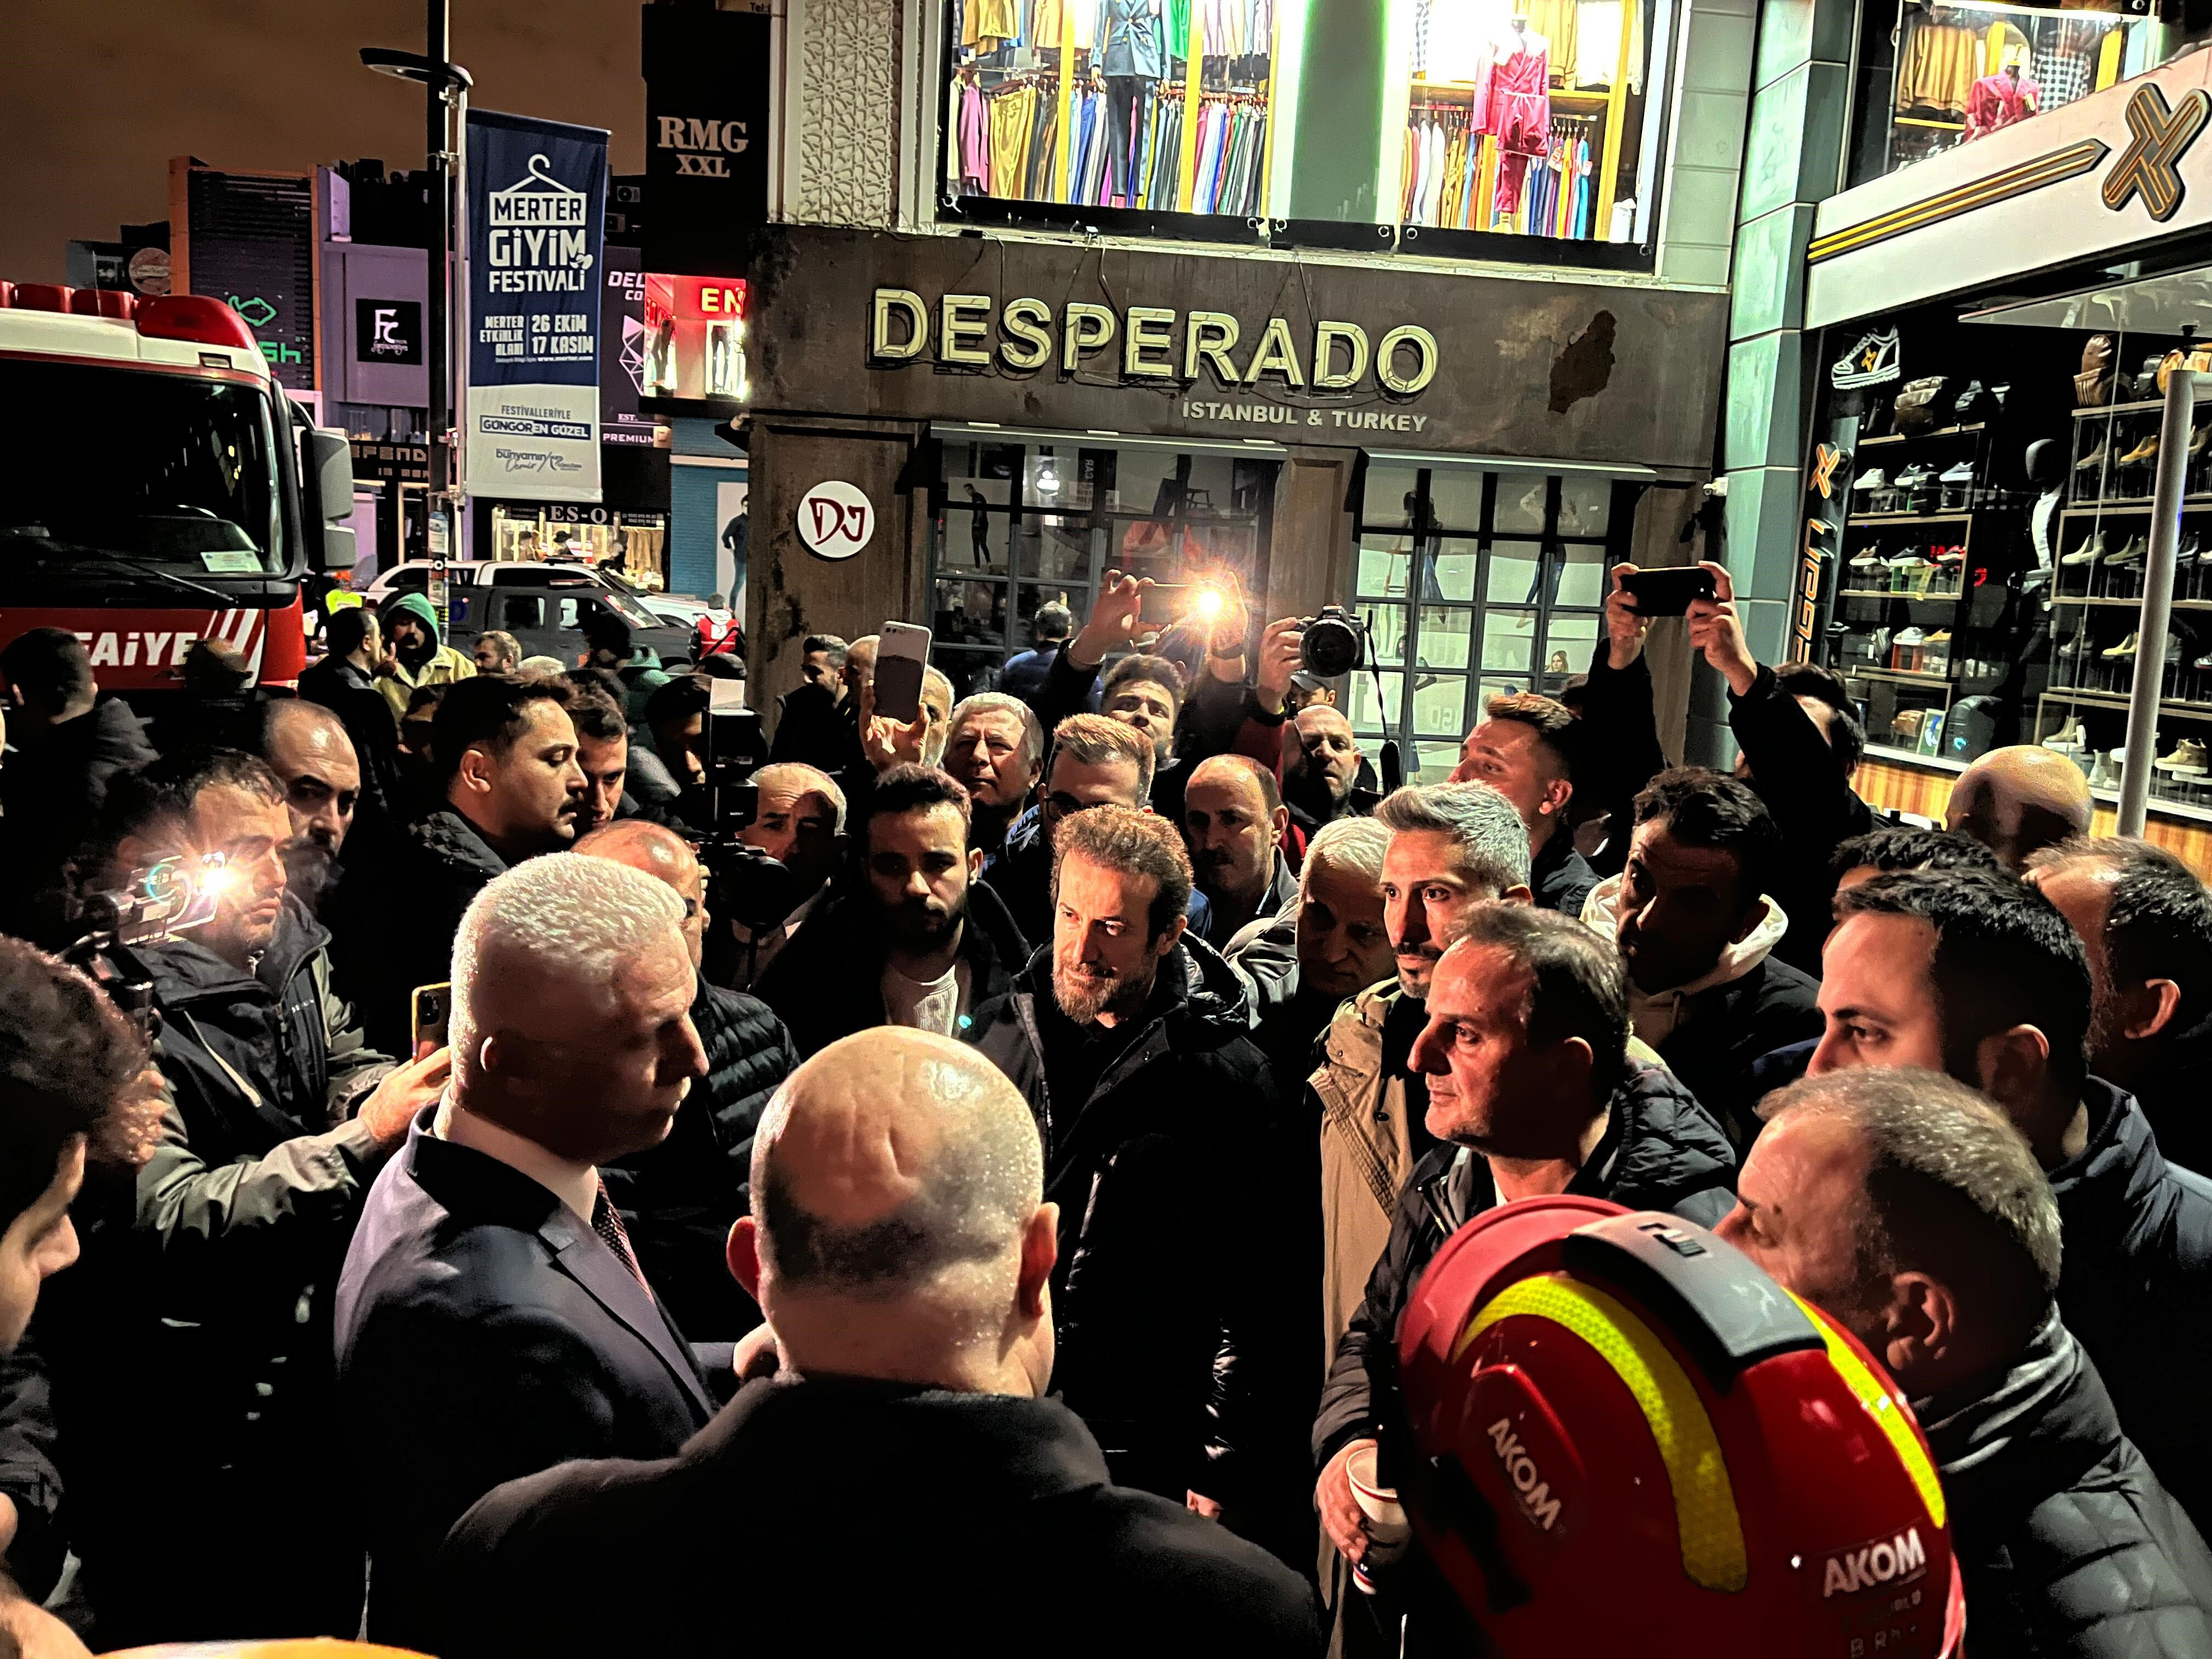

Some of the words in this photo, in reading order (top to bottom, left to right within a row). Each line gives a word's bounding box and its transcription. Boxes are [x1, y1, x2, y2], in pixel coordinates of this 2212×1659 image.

[657, 116, 748, 153] RMG
[676, 154, 730, 178] XXL
[494, 198, 582, 221] MERTER
[608, 271, 645, 287] DEL
[625, 290, 644, 301] CO
[702, 288, 744, 313] EN
[485, 316, 524, 328] MERTER
[532, 314, 550, 332] 26
[532, 336, 547, 354] 17
[550, 336, 594, 354] KASIM
[873, 288, 1438, 394] DESPERADO
[501, 405, 571, 420] FESTİVALLERİYLE
[618, 413, 638, 421] EST.
[1182, 397, 1298, 425] İSTANBUL
[1307, 409, 1323, 426] &
[1331, 410, 1427, 432] TURKEY
[1487, 1417, 1562, 1531] AKOM
[1823, 1527, 1926, 1598] AKOM
